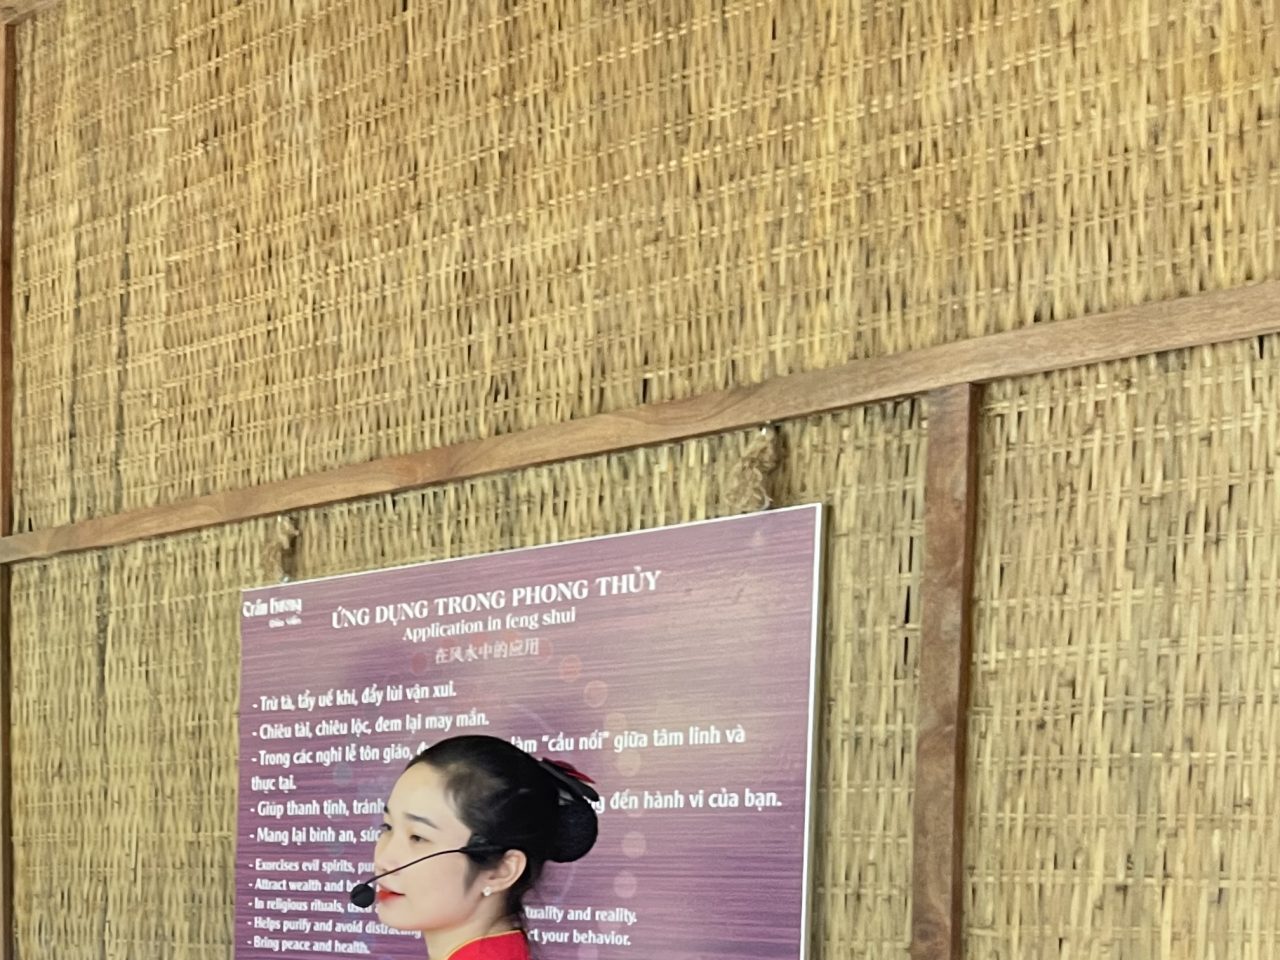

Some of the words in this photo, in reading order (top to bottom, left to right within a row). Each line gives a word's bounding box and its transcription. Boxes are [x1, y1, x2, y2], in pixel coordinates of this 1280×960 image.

[332, 606, 370, 629] ỨNG
[375, 599, 429, 626] DỤNG
[434, 590, 506, 617] TRONG
[512, 579, 589, 607] PHONG
[595, 566, 662, 597] THỦY
[402, 619, 484, 643] Application
[487, 615, 502, 631] in
[506, 612, 539, 631] feng
[541, 606, 576, 626] shui
[434, 637, 540, 665] 在风水中的应用
[406, 683, 430, 704] vận
[432, 681, 457, 699] xui.
[259, 723, 292, 740] Chiêu
[294, 721, 313, 739] tài,
[315, 719, 348, 737] chiêu
[351, 719, 372, 738] lộc,
[375, 716, 402, 733] đem
[406, 714, 421, 735] lại
[425, 715, 453, 732] may
[259, 750, 291, 768] Trong
[293, 748, 313, 765] các
[315, 746, 342, 766] nghi
[359, 744, 380, 761] tôn
[383, 743, 414, 764] giáo,
[614, 730, 648, 753] giữa
[653, 729, 684, 747] tâm
[688, 725, 721, 745] linh
[725, 724, 746, 744] và
[251, 776, 276, 794] thực
[257, 800, 284, 819] Giúp
[286, 799, 320, 816] thanh
[323, 798, 350, 818] tịnh,
[352, 797, 386, 815] tránh
[609, 788, 639, 810] đến
[643, 789, 685, 809] hành
[688, 789, 704, 808] vi
[708, 787, 739, 808] của
[744, 788, 783, 811] bạn.
[256, 827, 289, 846] Mang
[291, 826, 307, 846] lại
[338, 829, 357, 844] an,
[301, 859, 320, 872] evil
[321, 859, 356, 875] spirits,
[254, 878, 287, 891] Attract
[289, 879, 322, 892] wealth
[324, 879, 344, 892] and
[254, 897, 265, 909] In
[266, 898, 309, 914] religious
[310, 900, 345, 913] rituals,
[567, 906, 592, 921] and
[595, 907, 638, 926] reality.
[253, 936, 280, 951] Bring
[281, 939, 311, 952] peace
[312, 939, 333, 952] and
[334, 940, 371, 954] health.
[254, 917, 281, 931] Helps
[282, 918, 312, 933] purify
[313, 919, 333, 932] and
[335, 919, 363, 933] avoid
[541, 930, 570, 945] your
[572, 929, 632, 946] behavior.
